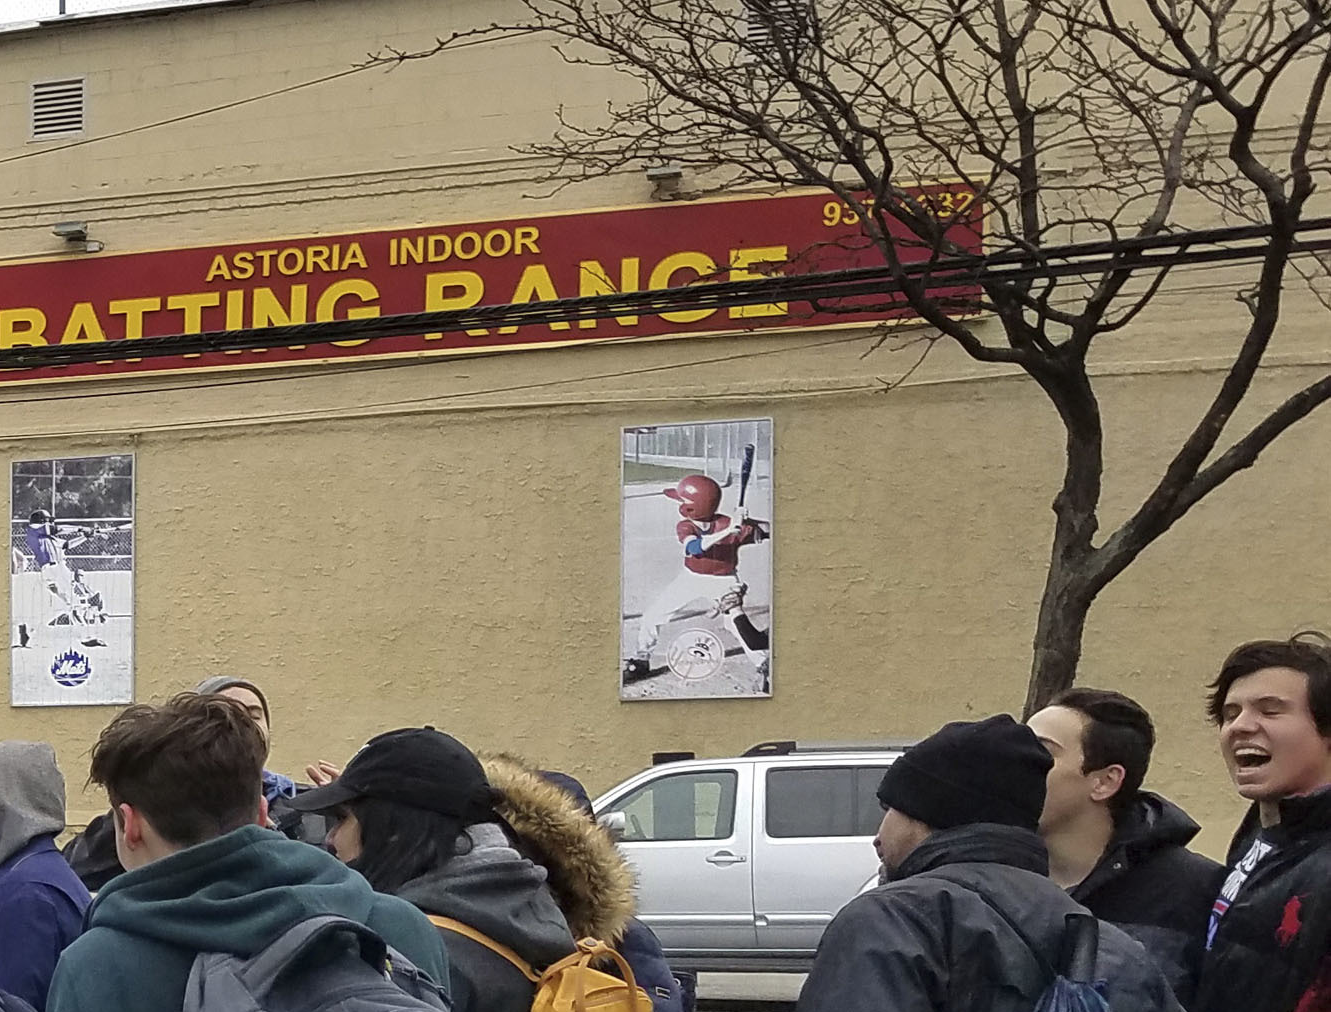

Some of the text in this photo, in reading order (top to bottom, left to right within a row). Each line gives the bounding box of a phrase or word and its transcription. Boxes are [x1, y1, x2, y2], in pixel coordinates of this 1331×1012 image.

[206, 226, 542, 283] ASTORIA INDOOR
[423, 245, 789, 341] RANGE
